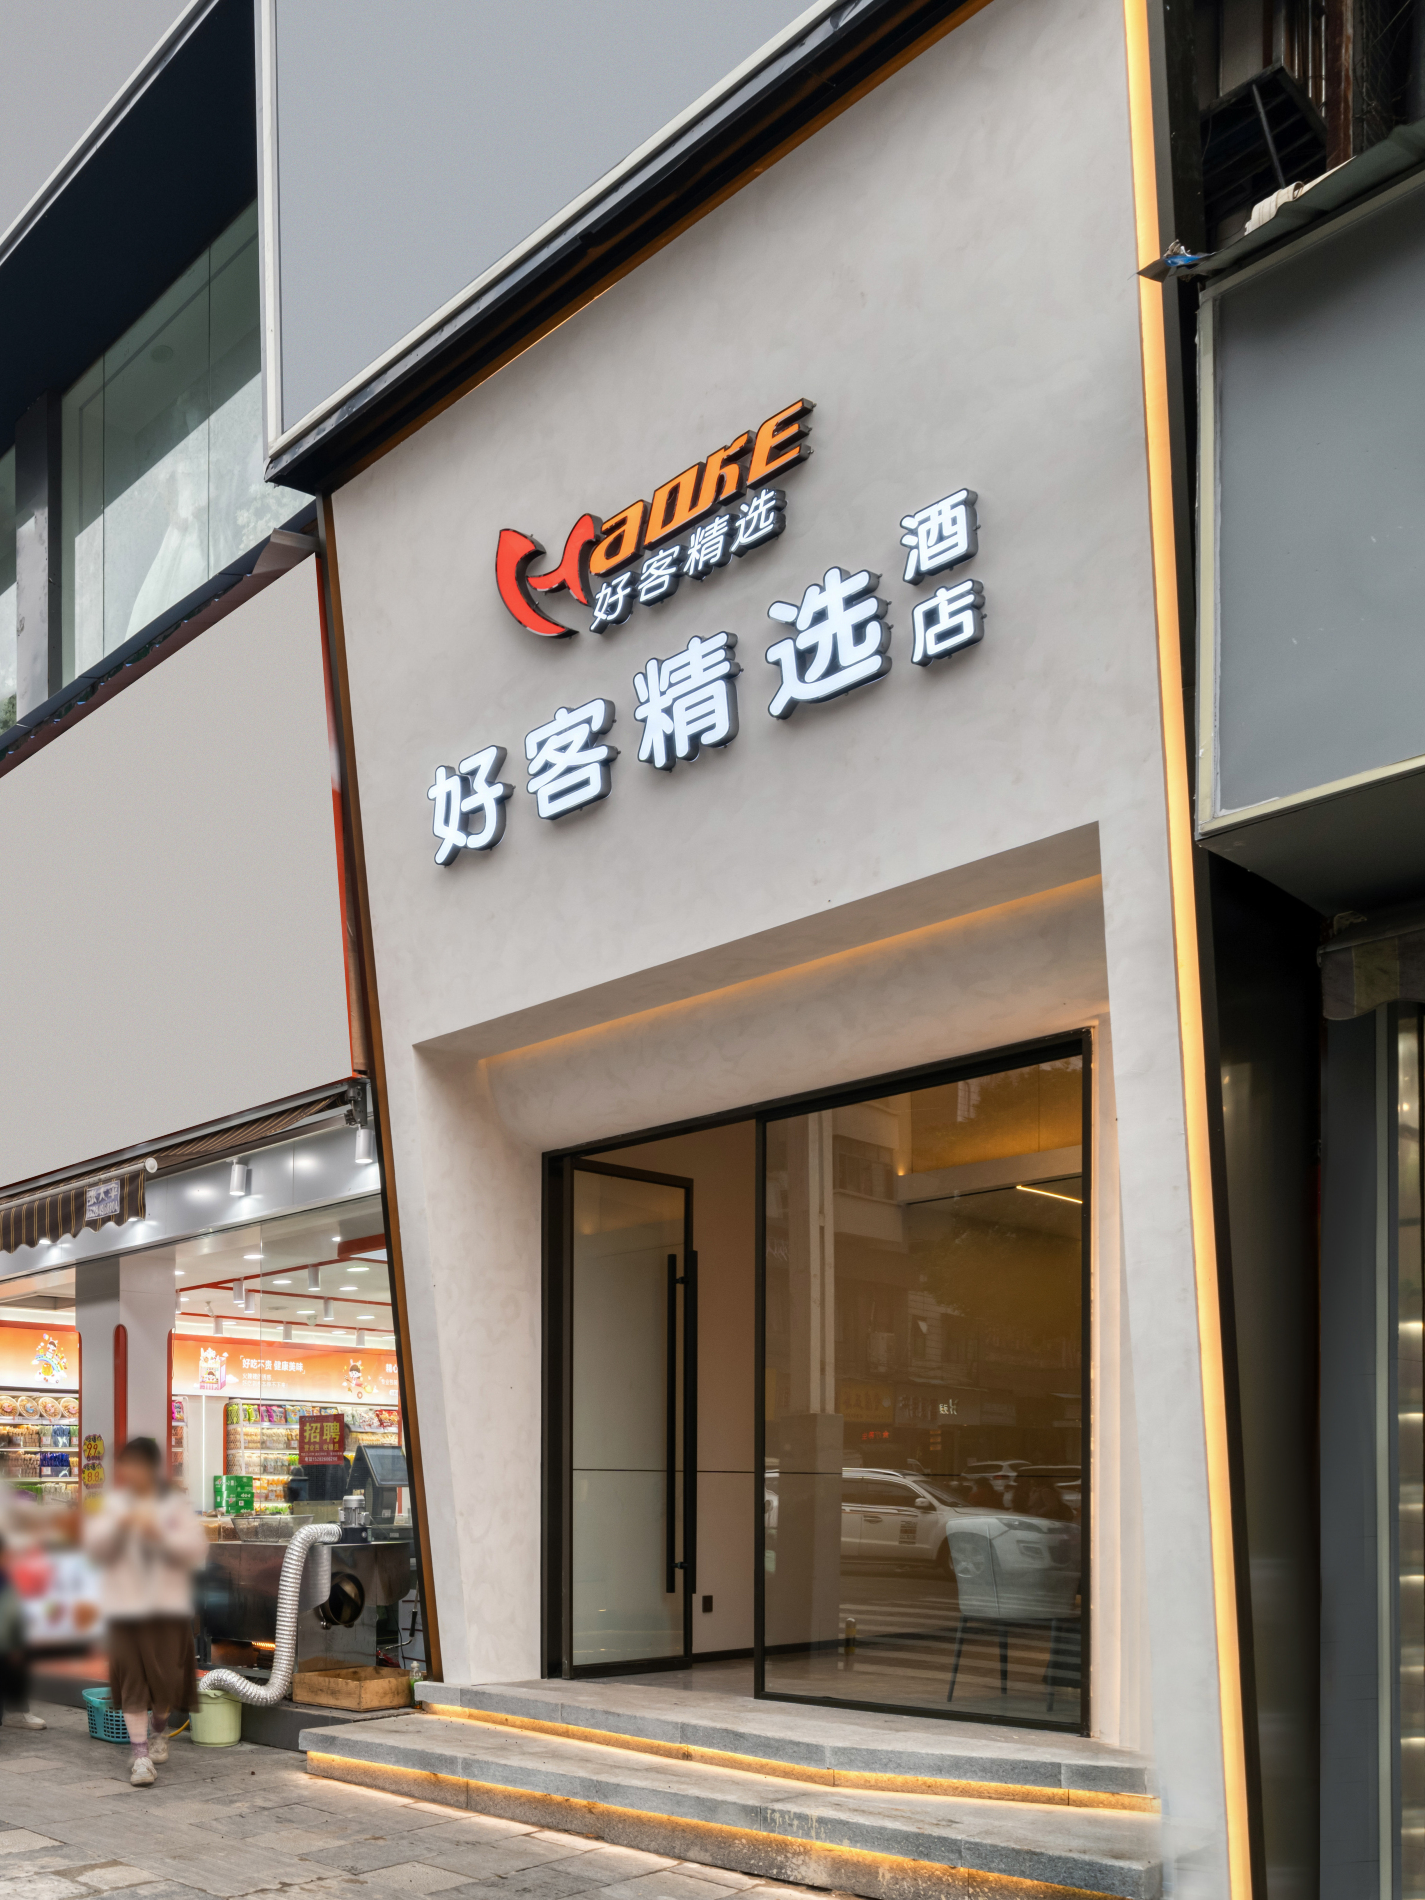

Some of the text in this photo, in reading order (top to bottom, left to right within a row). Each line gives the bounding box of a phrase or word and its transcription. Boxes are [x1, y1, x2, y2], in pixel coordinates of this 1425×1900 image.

[589, 487, 787, 634] 好客精选
[900, 487, 986, 666] 酒店
[427, 566, 894, 867] 好客精选
[303, 1421, 340, 1443] 招聘
